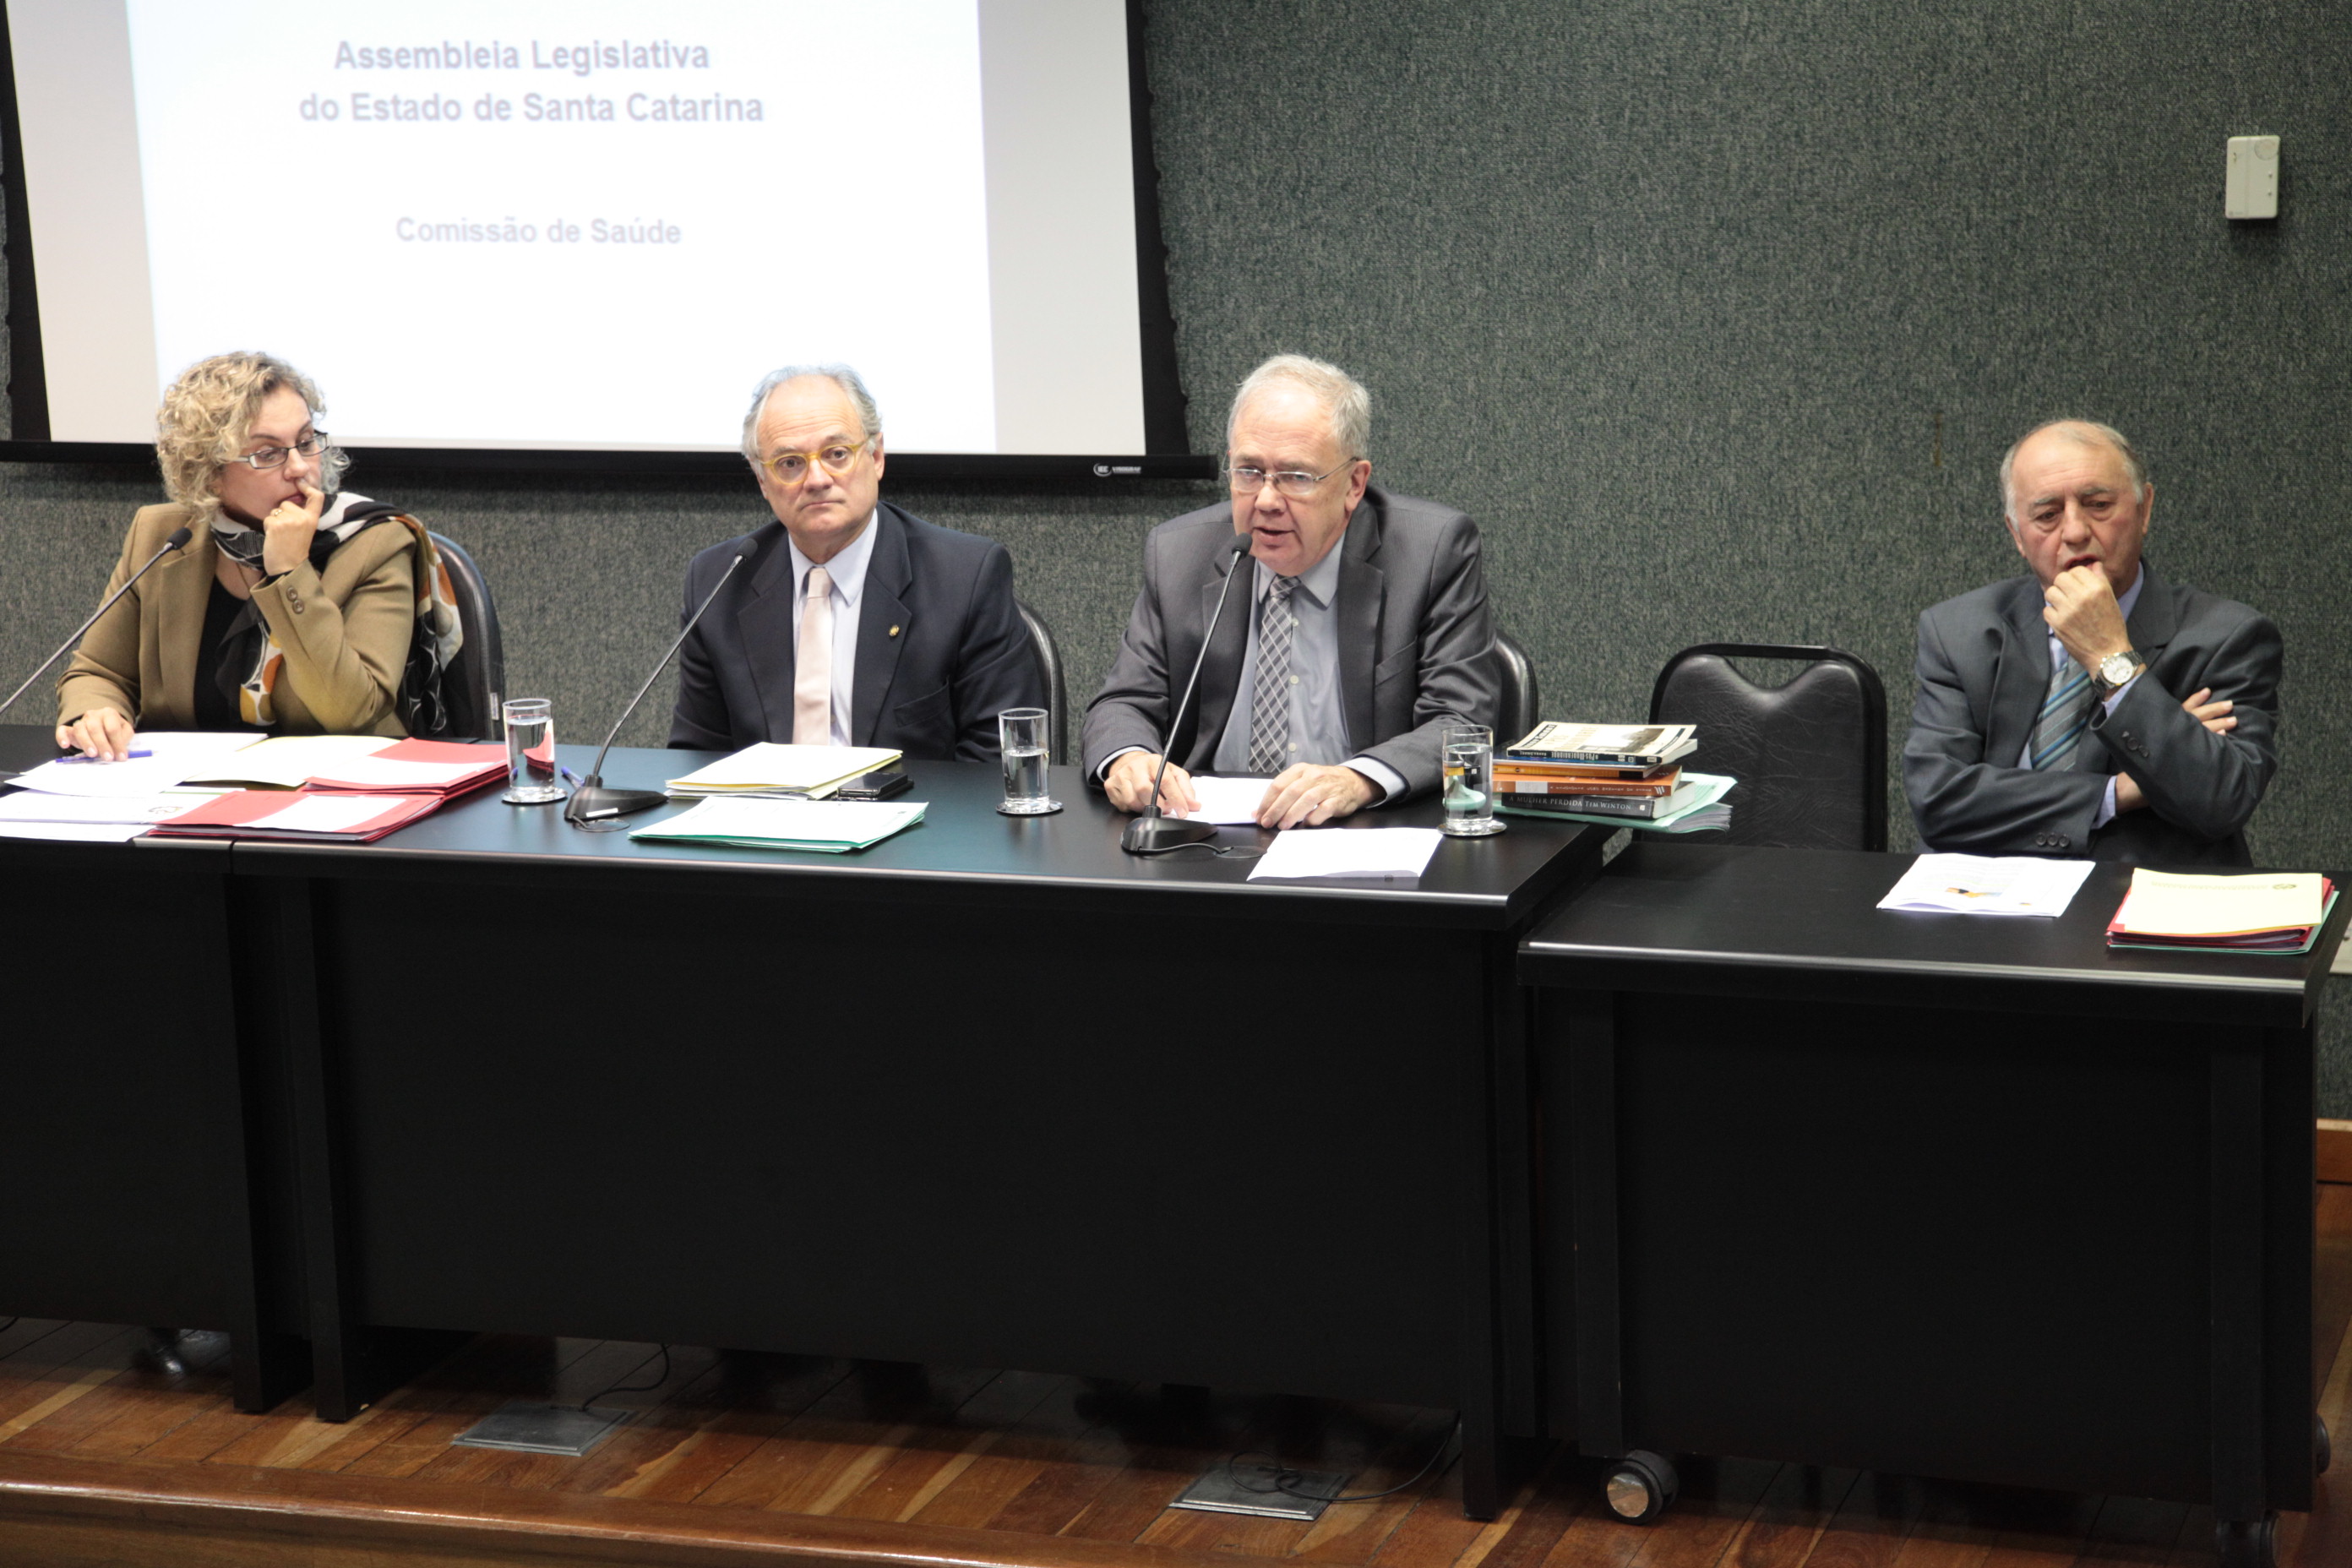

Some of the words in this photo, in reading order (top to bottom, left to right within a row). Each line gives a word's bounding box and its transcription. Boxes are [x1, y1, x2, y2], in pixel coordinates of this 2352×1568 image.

[334, 40, 520, 69] Assembleia
[531, 39, 710, 77] Legislativa
[299, 93, 340, 121] do
[351, 92, 462, 122] Estado
[473, 93, 512, 122] de
[523, 92, 615, 122] Santa
[626, 92, 764, 122] Catarina
[395, 215, 537, 242] Comissão
[547, 218, 580, 243] de
[591, 217, 682, 244] Saúde
[1549, 798, 1582, 807] PERDIDA
[1600, 802, 1631, 810] WINTON
